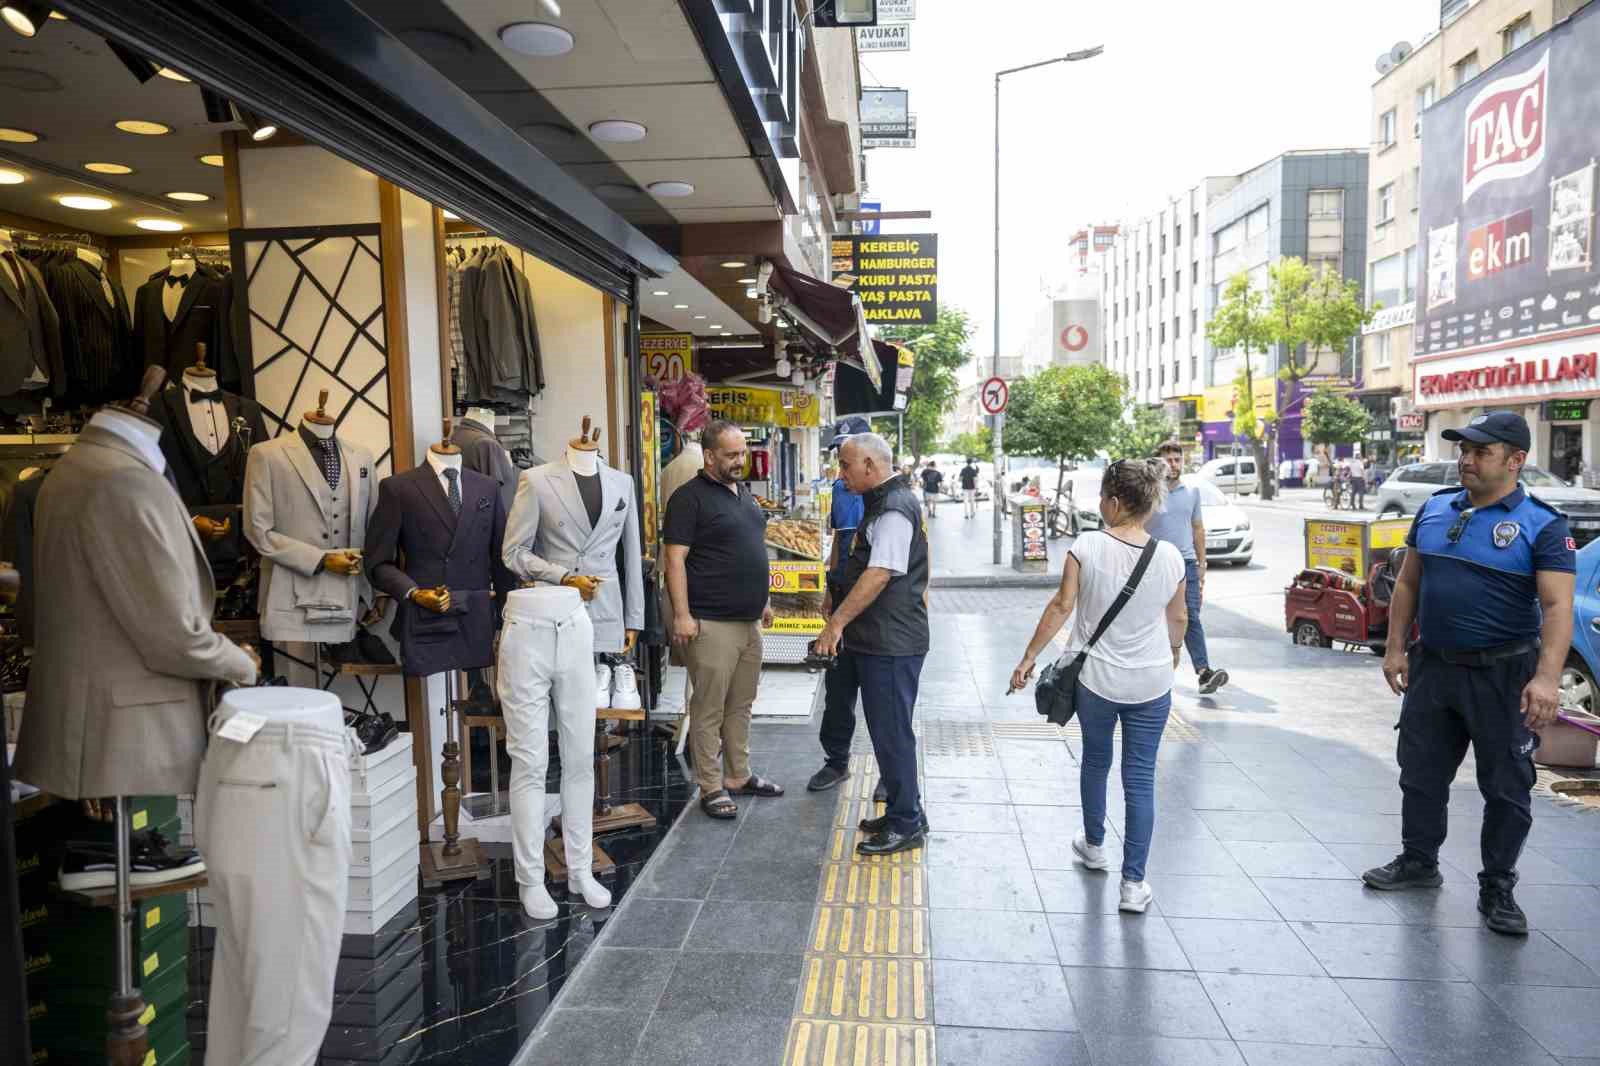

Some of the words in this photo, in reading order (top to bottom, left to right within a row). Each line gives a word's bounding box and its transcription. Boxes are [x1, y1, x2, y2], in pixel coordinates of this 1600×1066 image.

[860, 27, 905, 39] AVUKAT
[860, 240, 919, 255] KEREBİÇ
[1469, 230, 1530, 275] ekm
[860, 258, 935, 270] HAMBURGER
[859, 275, 895, 286] KURU
[898, 274, 937, 286] PASTA
[860, 291, 885, 304] YAŞ
[889, 290, 931, 302] PASTA
